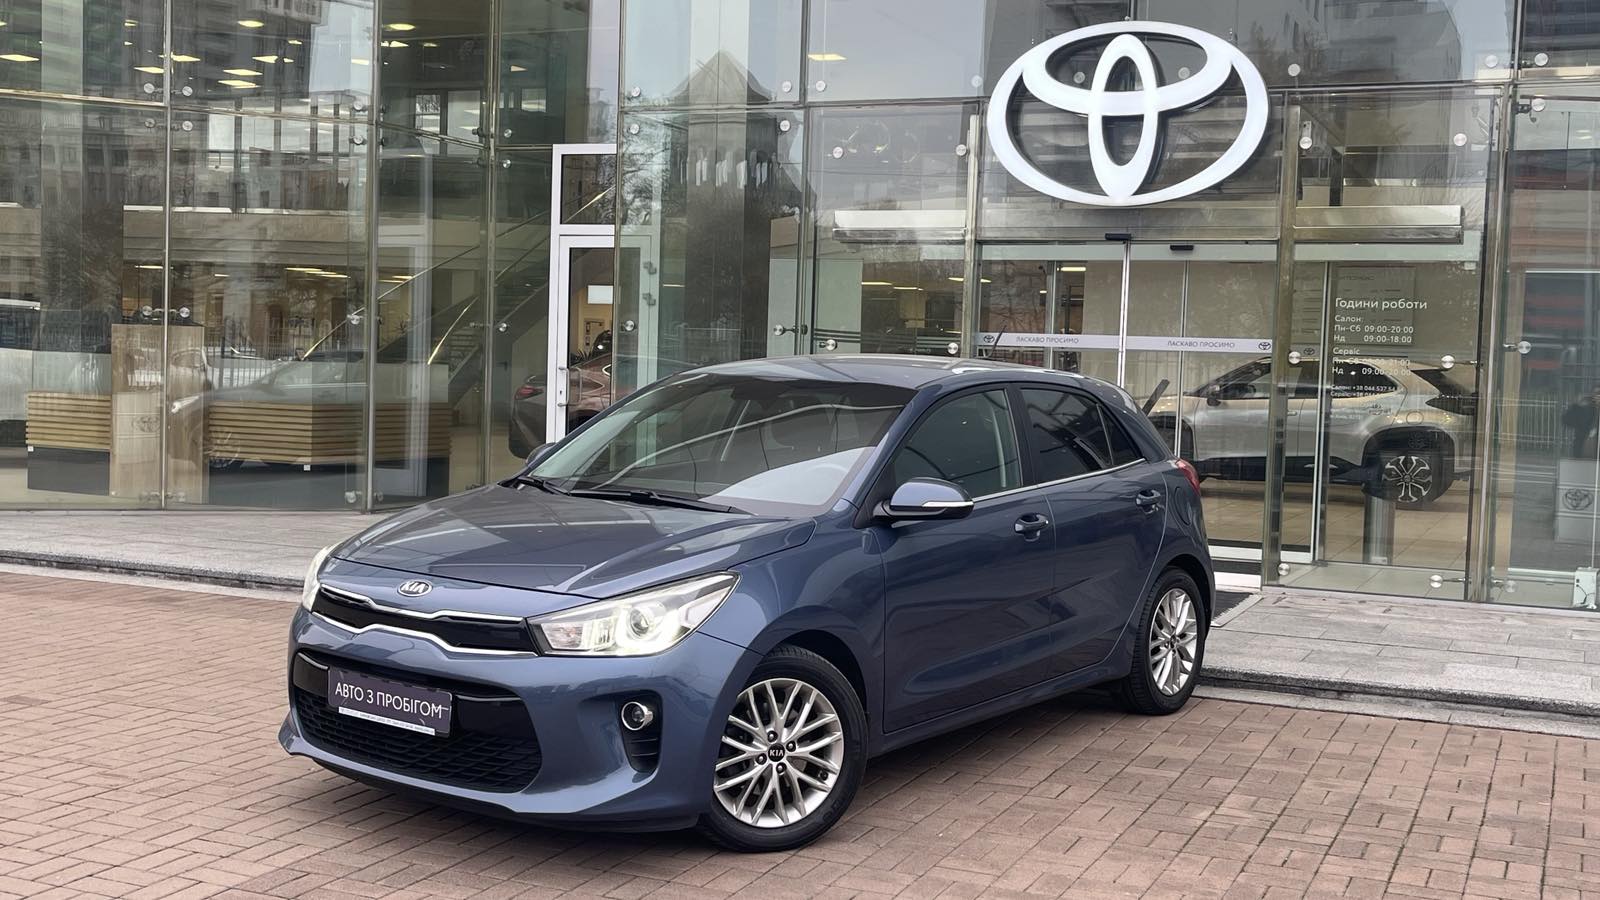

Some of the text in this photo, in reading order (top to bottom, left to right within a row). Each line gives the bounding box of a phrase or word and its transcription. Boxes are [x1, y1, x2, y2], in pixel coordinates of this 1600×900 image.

[1335, 297, 1428, 311] Години роботи
[1334, 324, 1361, 332] Пн-Сб
[1333, 334, 1346, 342] Нд
[1331, 366, 1344, 375] Нд
[400, 581, 427, 594] KIA
[335, 682, 364, 701] АВТО
[376, 691, 442, 719] ПРОБІГОМ
[769, 749, 784, 757] KIA
